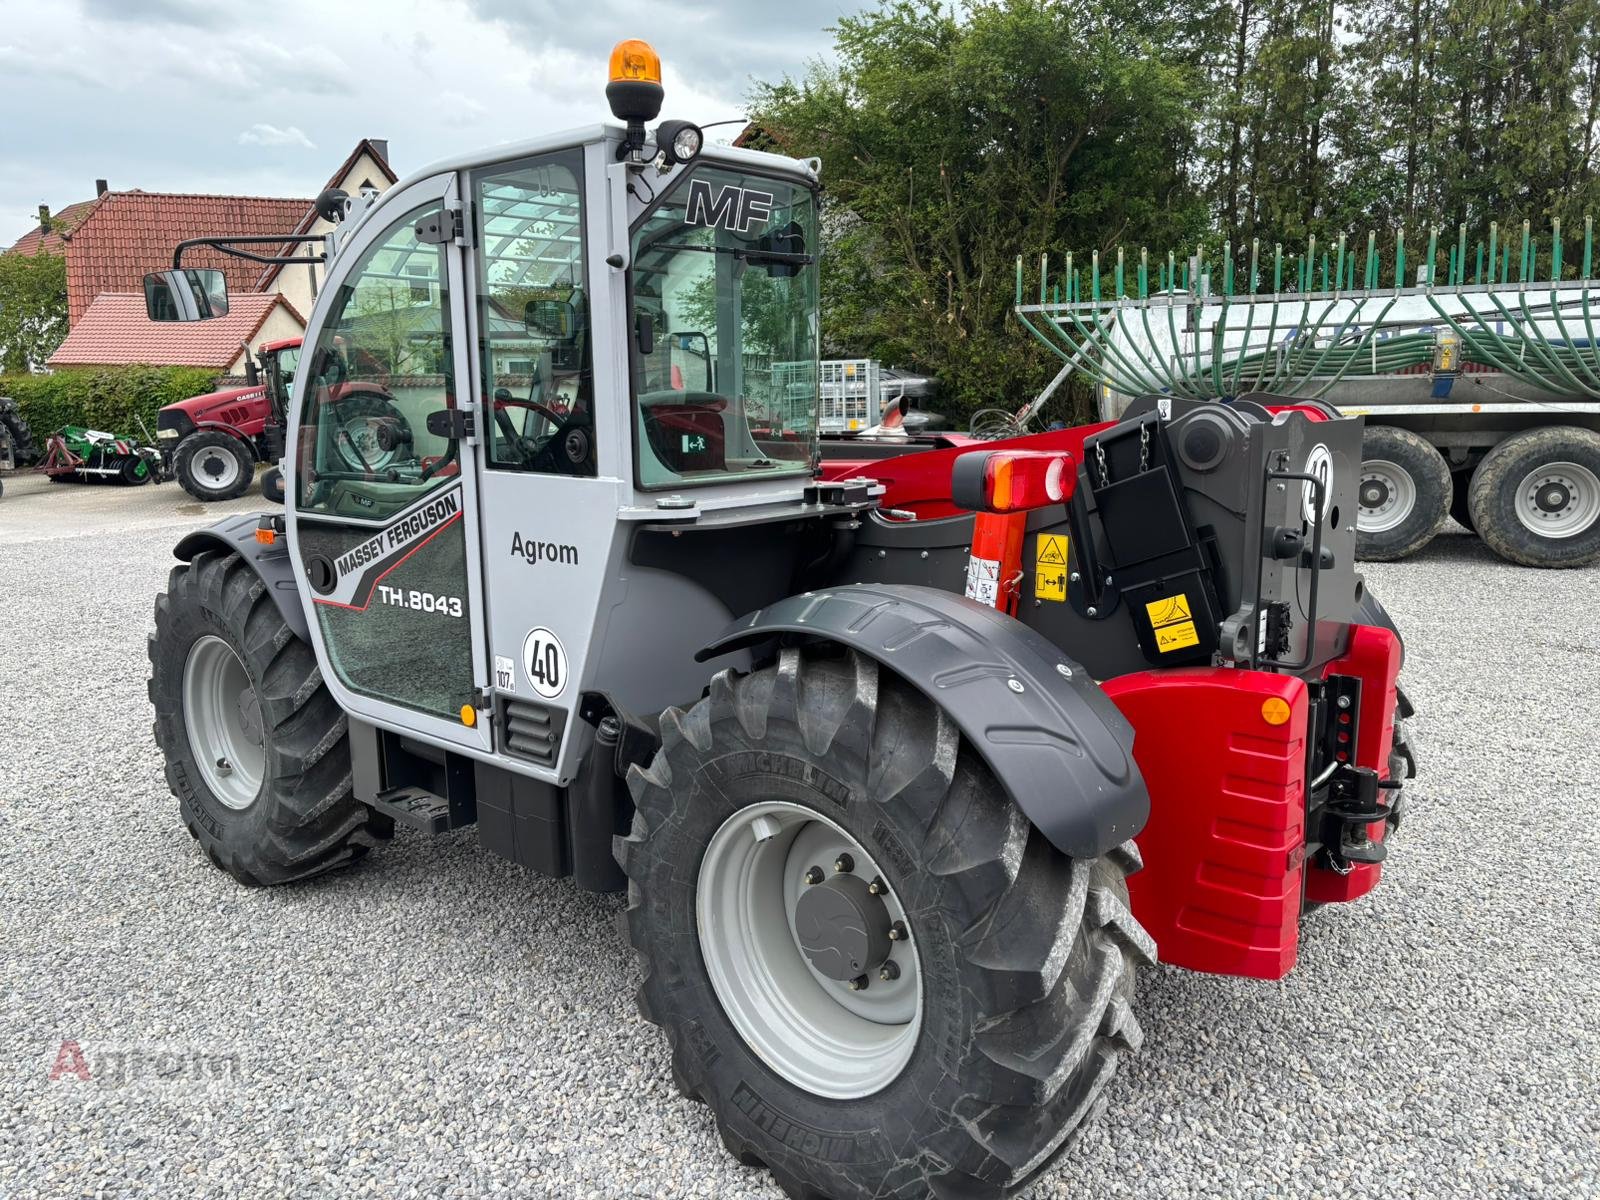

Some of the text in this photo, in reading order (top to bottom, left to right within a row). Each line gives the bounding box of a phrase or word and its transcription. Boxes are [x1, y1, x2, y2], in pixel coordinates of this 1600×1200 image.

[684, 178, 774, 232] MF
[237, 393, 255, 402] CASE
[337, 493, 458, 577] MASSEY FERGUSON
[510, 531, 579, 565] Agrom
[378, 584, 463, 618] TH.8043
[496, 670, 510, 689] 107
[531, 639, 559, 688] 40
[732, 1087, 855, 1162] MICHELIN
